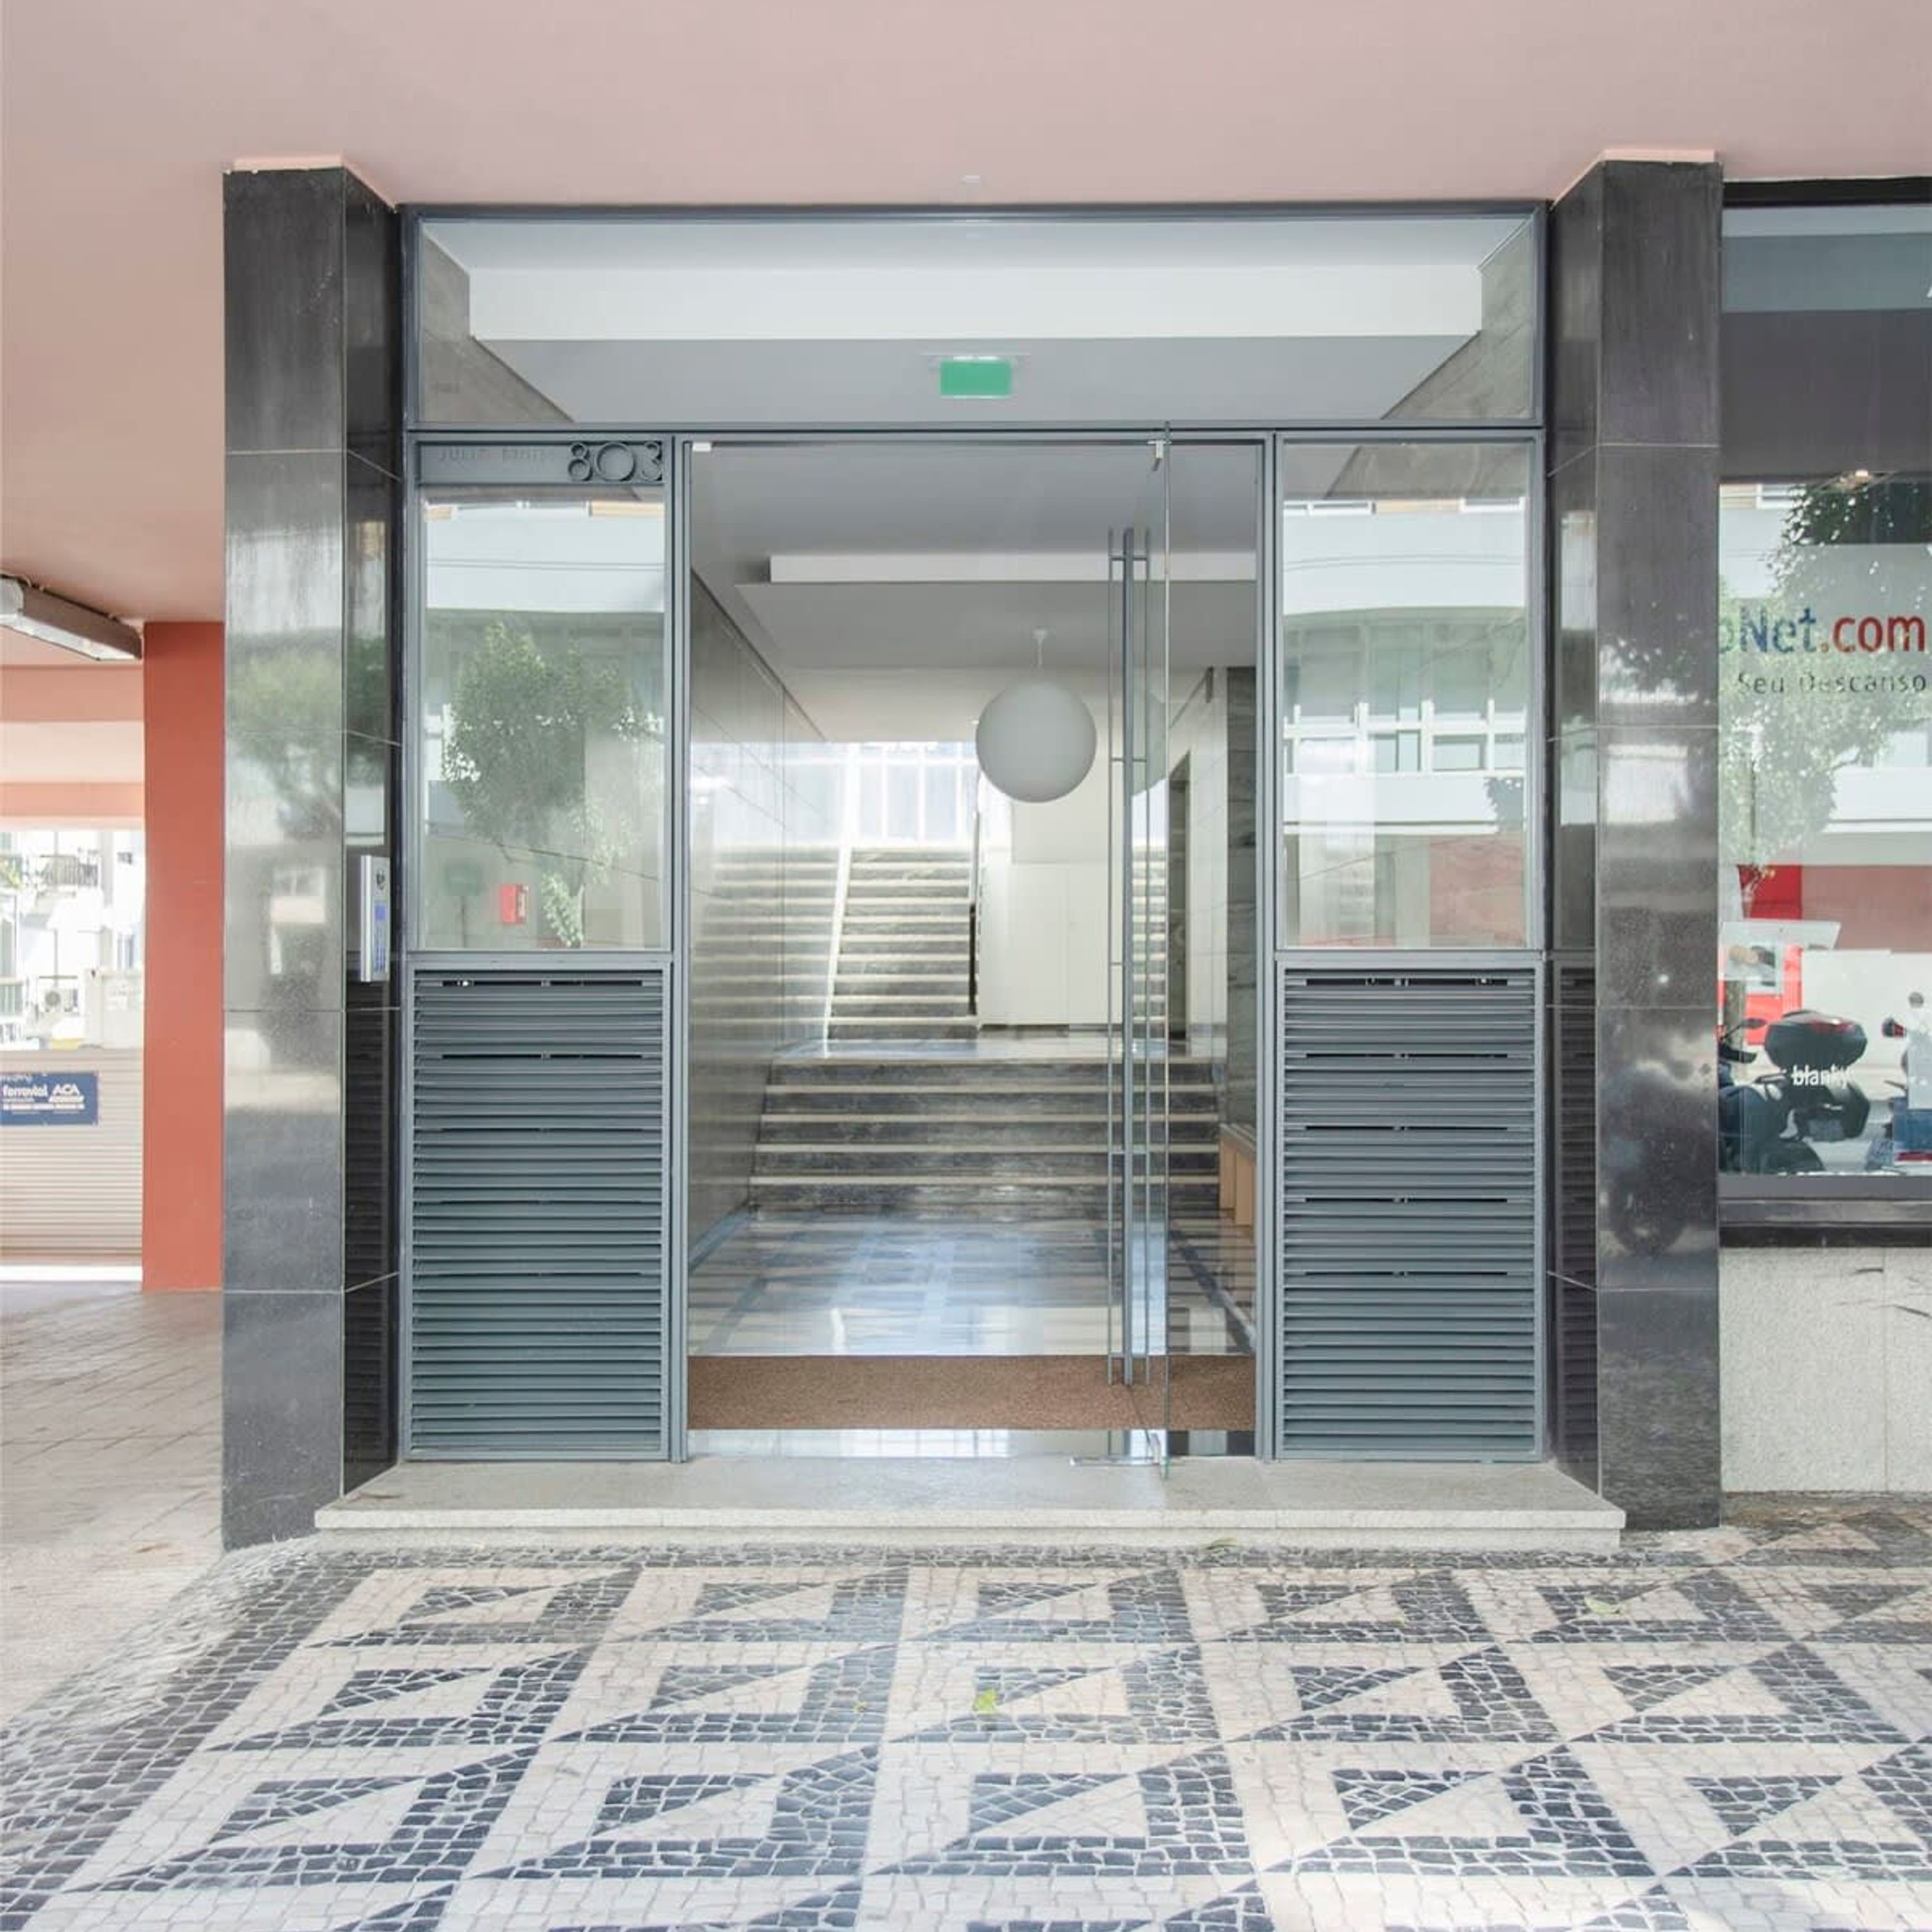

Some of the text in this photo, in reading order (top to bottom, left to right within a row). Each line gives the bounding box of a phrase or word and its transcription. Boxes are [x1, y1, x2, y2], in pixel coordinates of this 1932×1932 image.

[569, 442, 662, 482] 803
[1738, 671, 1927, 694] Seu Descanso
